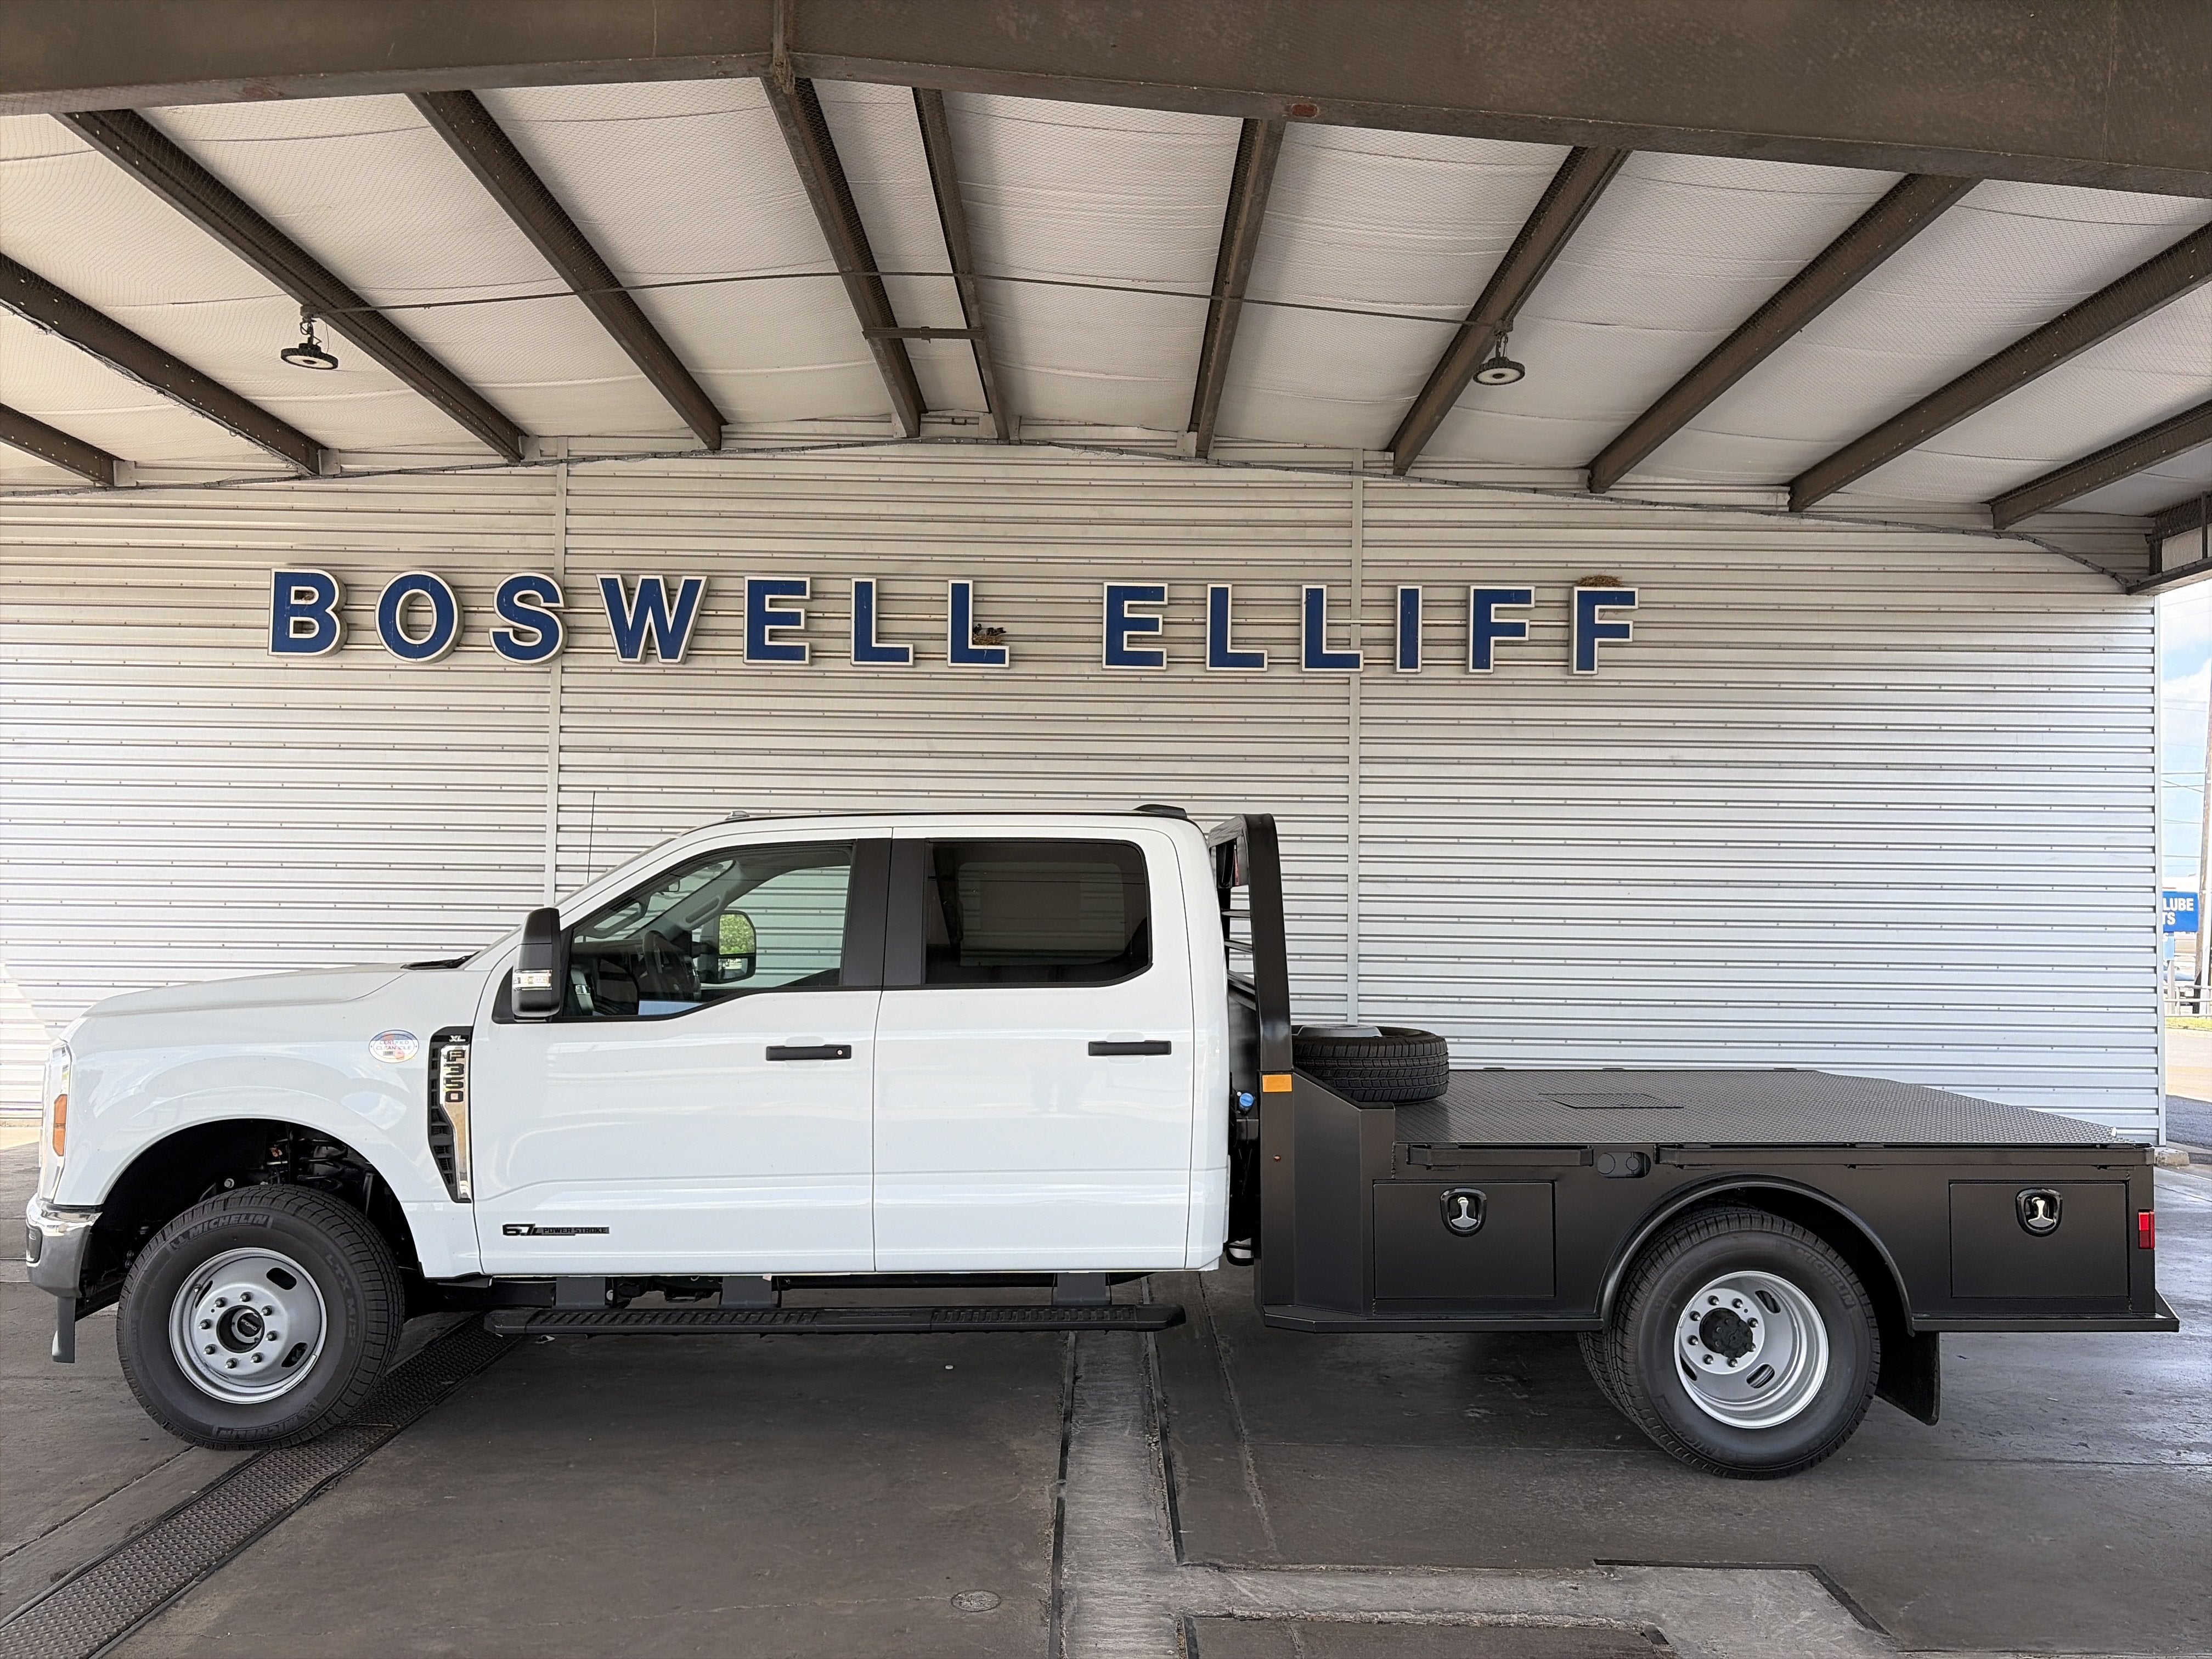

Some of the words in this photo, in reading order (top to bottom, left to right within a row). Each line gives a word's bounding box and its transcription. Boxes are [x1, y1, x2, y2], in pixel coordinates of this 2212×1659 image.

[268, 567, 1010, 668] BOSWELL
[1102, 582, 1639, 675] ELLIFF
[2163, 898, 2194, 911] LUBE
[449, 1035, 466, 1043] XL
[189, 1214, 269, 1239] MICHELIN
[325, 1254, 351, 1291] LTX
[240, 1319, 258, 1331] FORD
